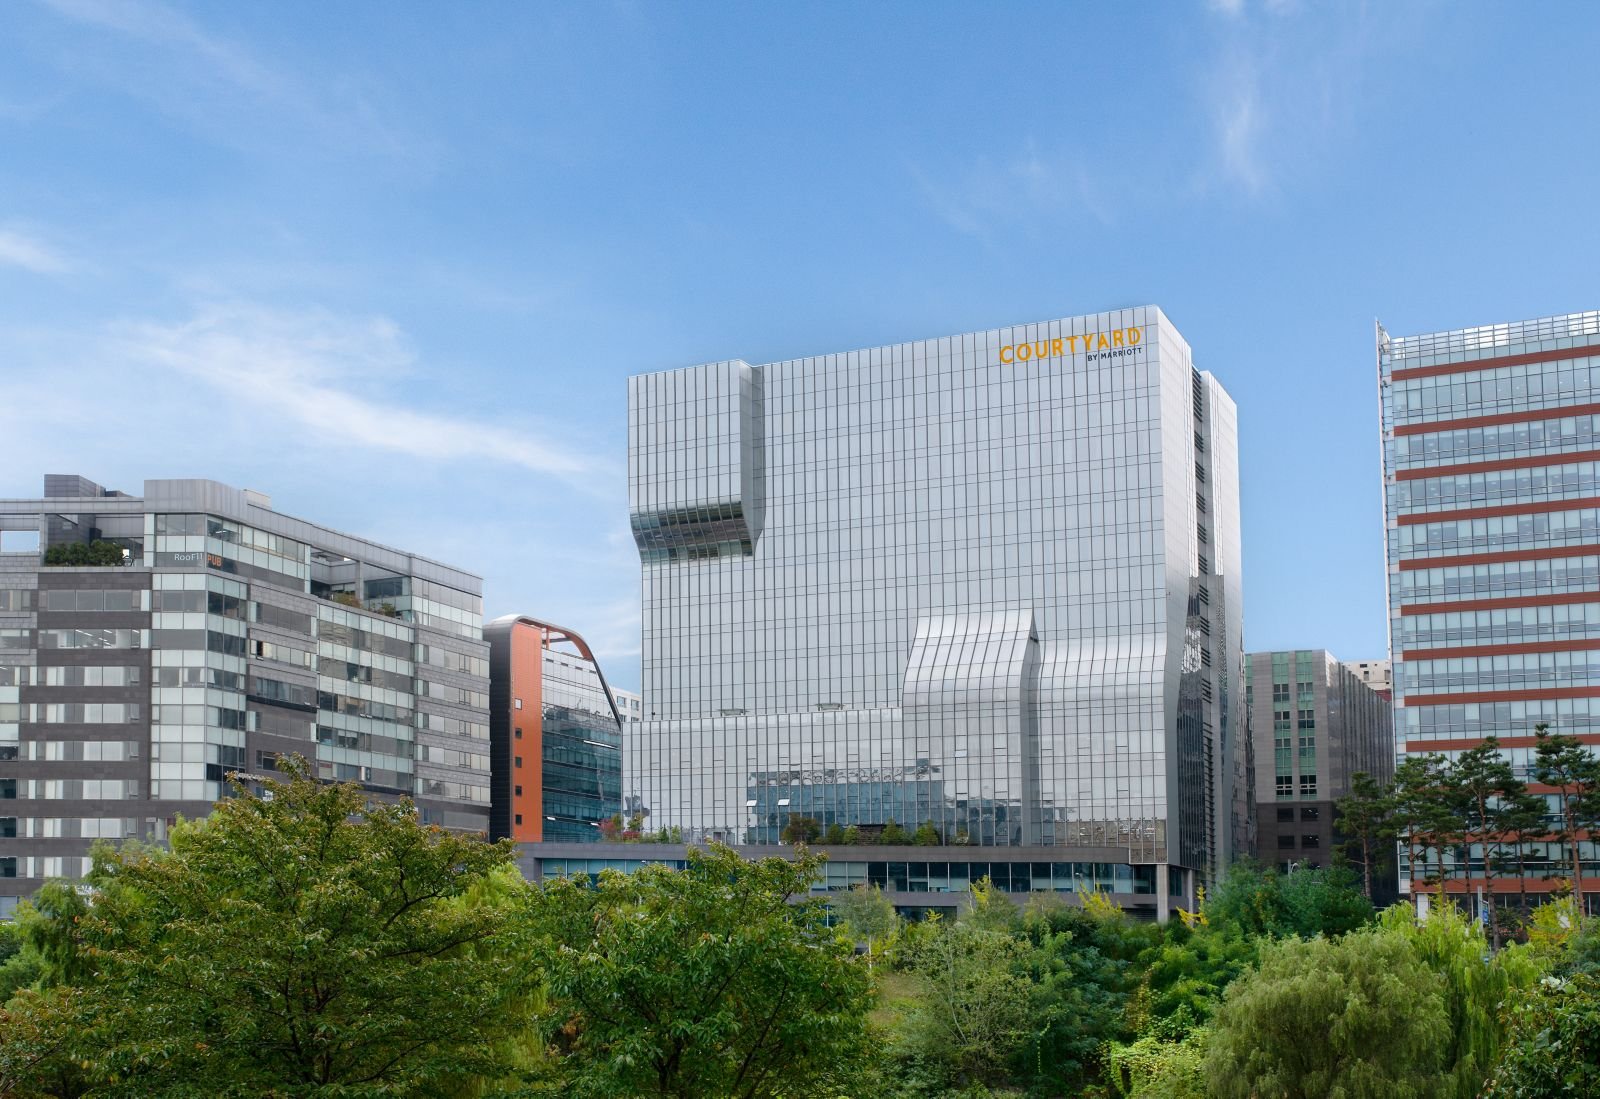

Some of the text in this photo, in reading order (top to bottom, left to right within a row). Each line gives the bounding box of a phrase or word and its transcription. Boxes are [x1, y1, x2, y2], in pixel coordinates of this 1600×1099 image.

[1000, 326, 1141, 364] COURTYARD
[1087, 347, 1142, 362] BY MARRIOTT
[207, 554, 222, 567] PUB
